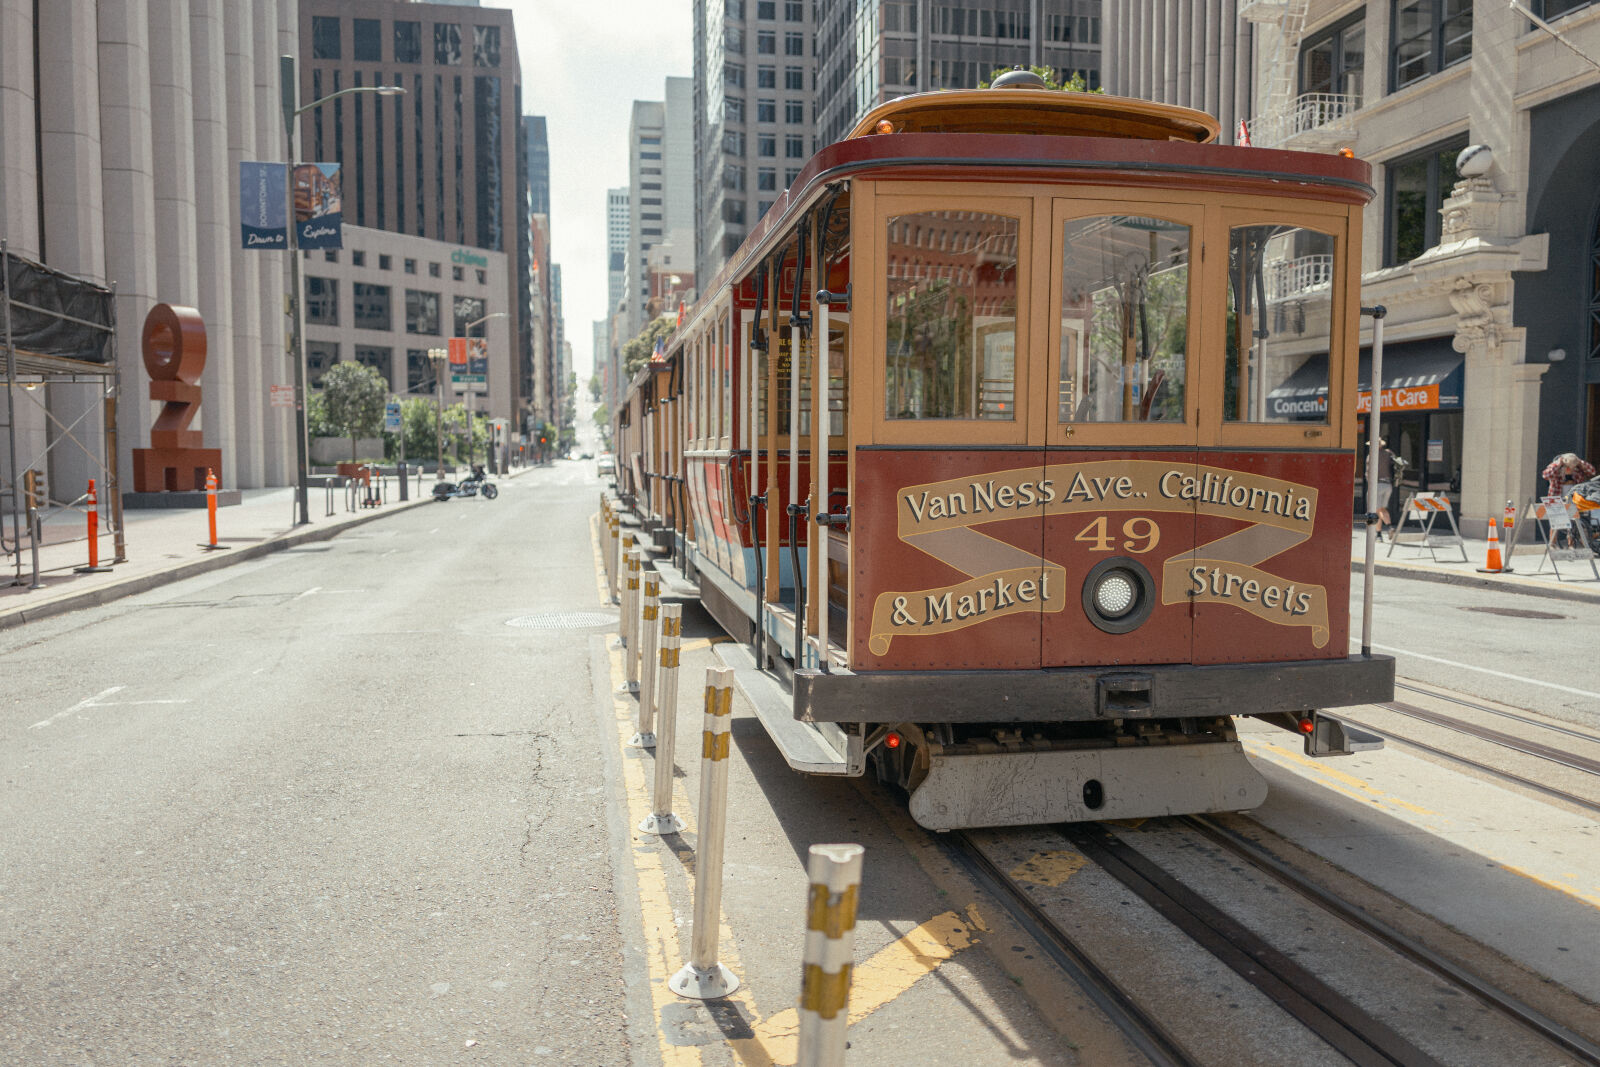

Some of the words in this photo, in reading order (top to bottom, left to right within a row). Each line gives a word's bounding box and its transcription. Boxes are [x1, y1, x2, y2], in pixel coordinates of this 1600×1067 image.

[259, 179, 267, 227] DOWNTOWN
[303, 225, 336, 239] Explore
[1396, 389, 1427, 406] Care
[905, 491, 967, 523] Van
[970, 480, 1056, 513] Ness
[1159, 471, 1311, 521] California
[1075, 516, 1161, 554] 49
[891, 596, 918, 626] &
[922, 572, 1051, 626] Market
[1186, 566, 1313, 616] Streets
